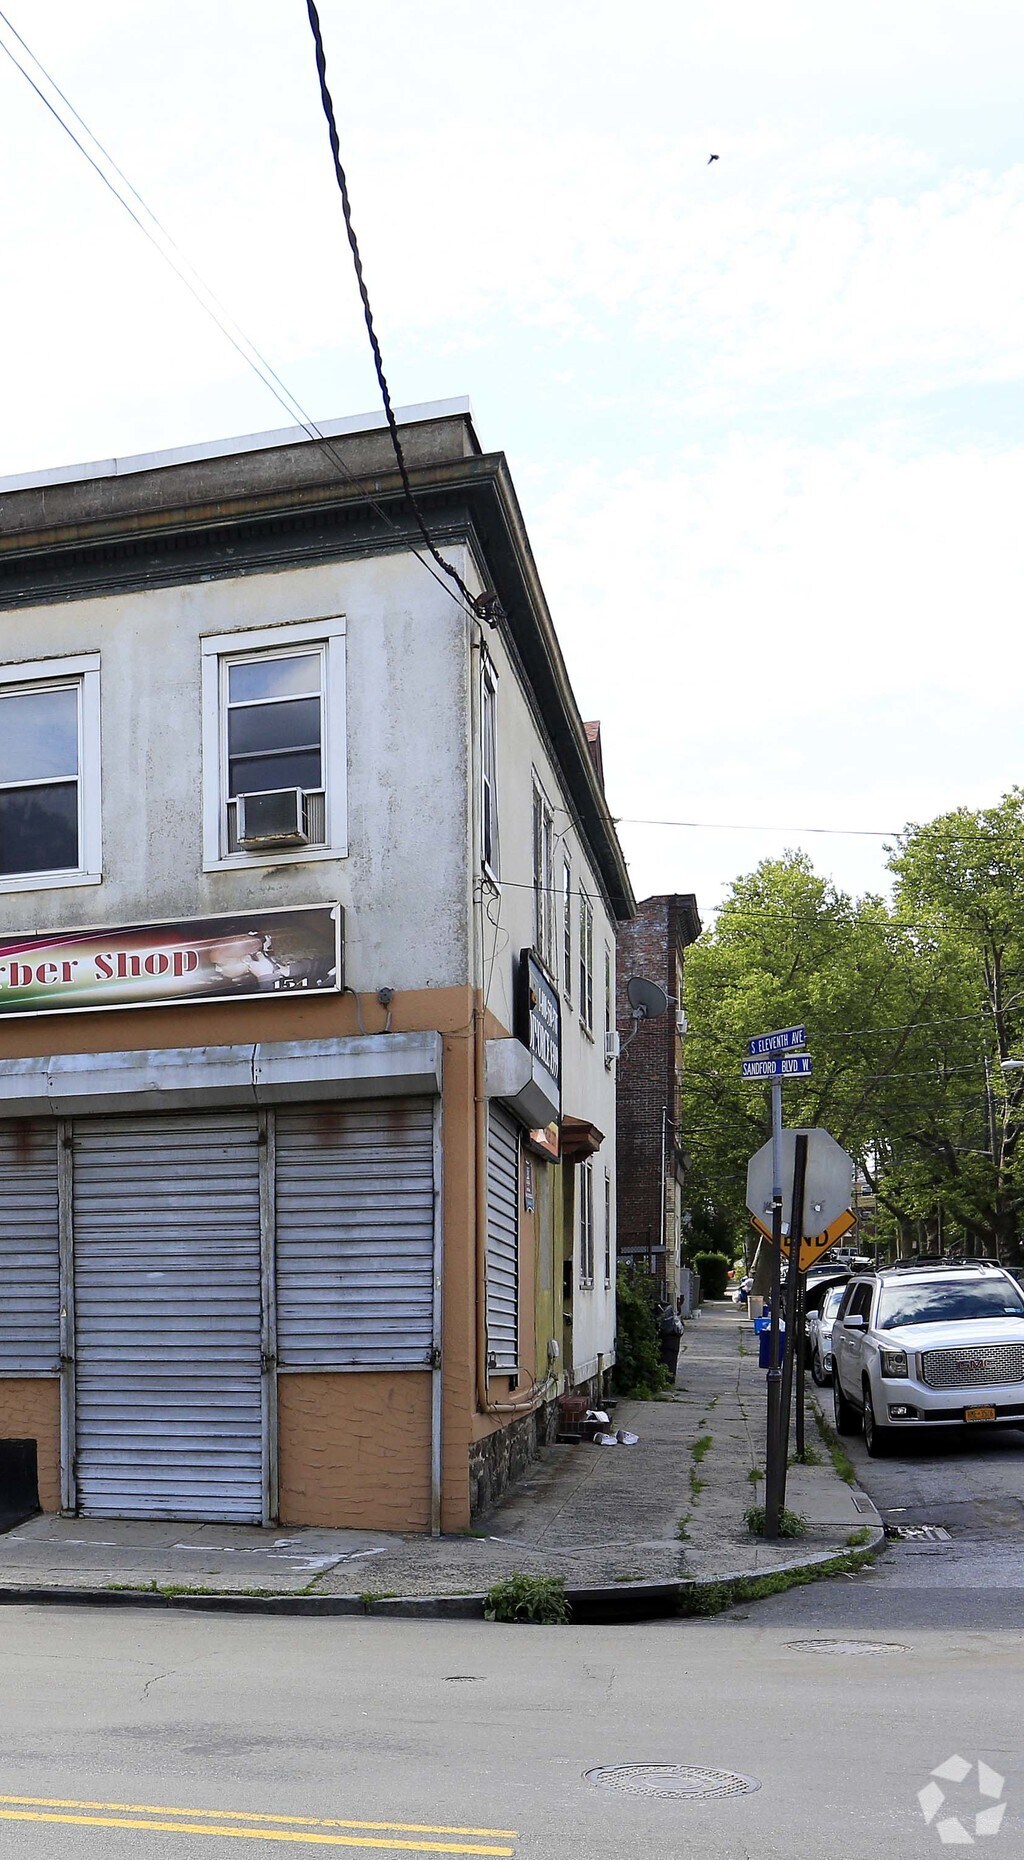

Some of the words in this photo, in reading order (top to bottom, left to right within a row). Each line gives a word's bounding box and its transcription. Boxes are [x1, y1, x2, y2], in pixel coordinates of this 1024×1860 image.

[94, 946, 199, 981] Shop
[751, 1041, 756, 1054] S
[758, 1034, 789, 1053] ELEVENTH
[791, 1029, 804, 1045] AVE
[742, 1061, 777, 1076] SANDFORD
[781, 1059, 798, 1073] BLVD
[802, 1058, 810, 1071] W
[956, 1359, 993, 1371] GMC
